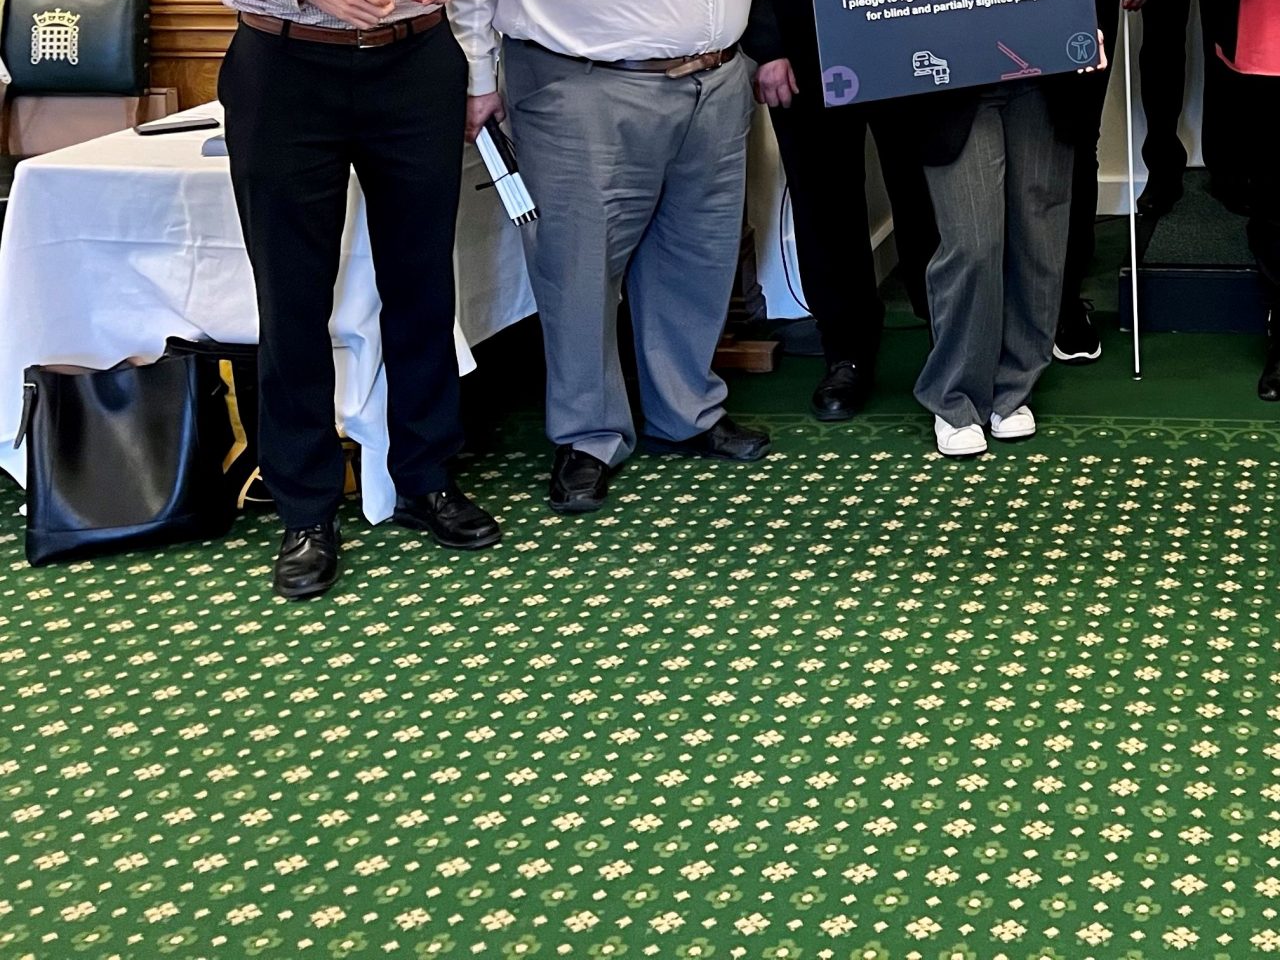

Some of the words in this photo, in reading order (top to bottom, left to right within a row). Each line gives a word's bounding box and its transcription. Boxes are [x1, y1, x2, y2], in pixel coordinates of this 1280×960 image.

[842, 0, 847, 8] I
[866, 11, 882, 21] for
[883, 7, 910, 19] blind
[911, 4, 931, 15] and
[933, 0, 974, 14] partially
